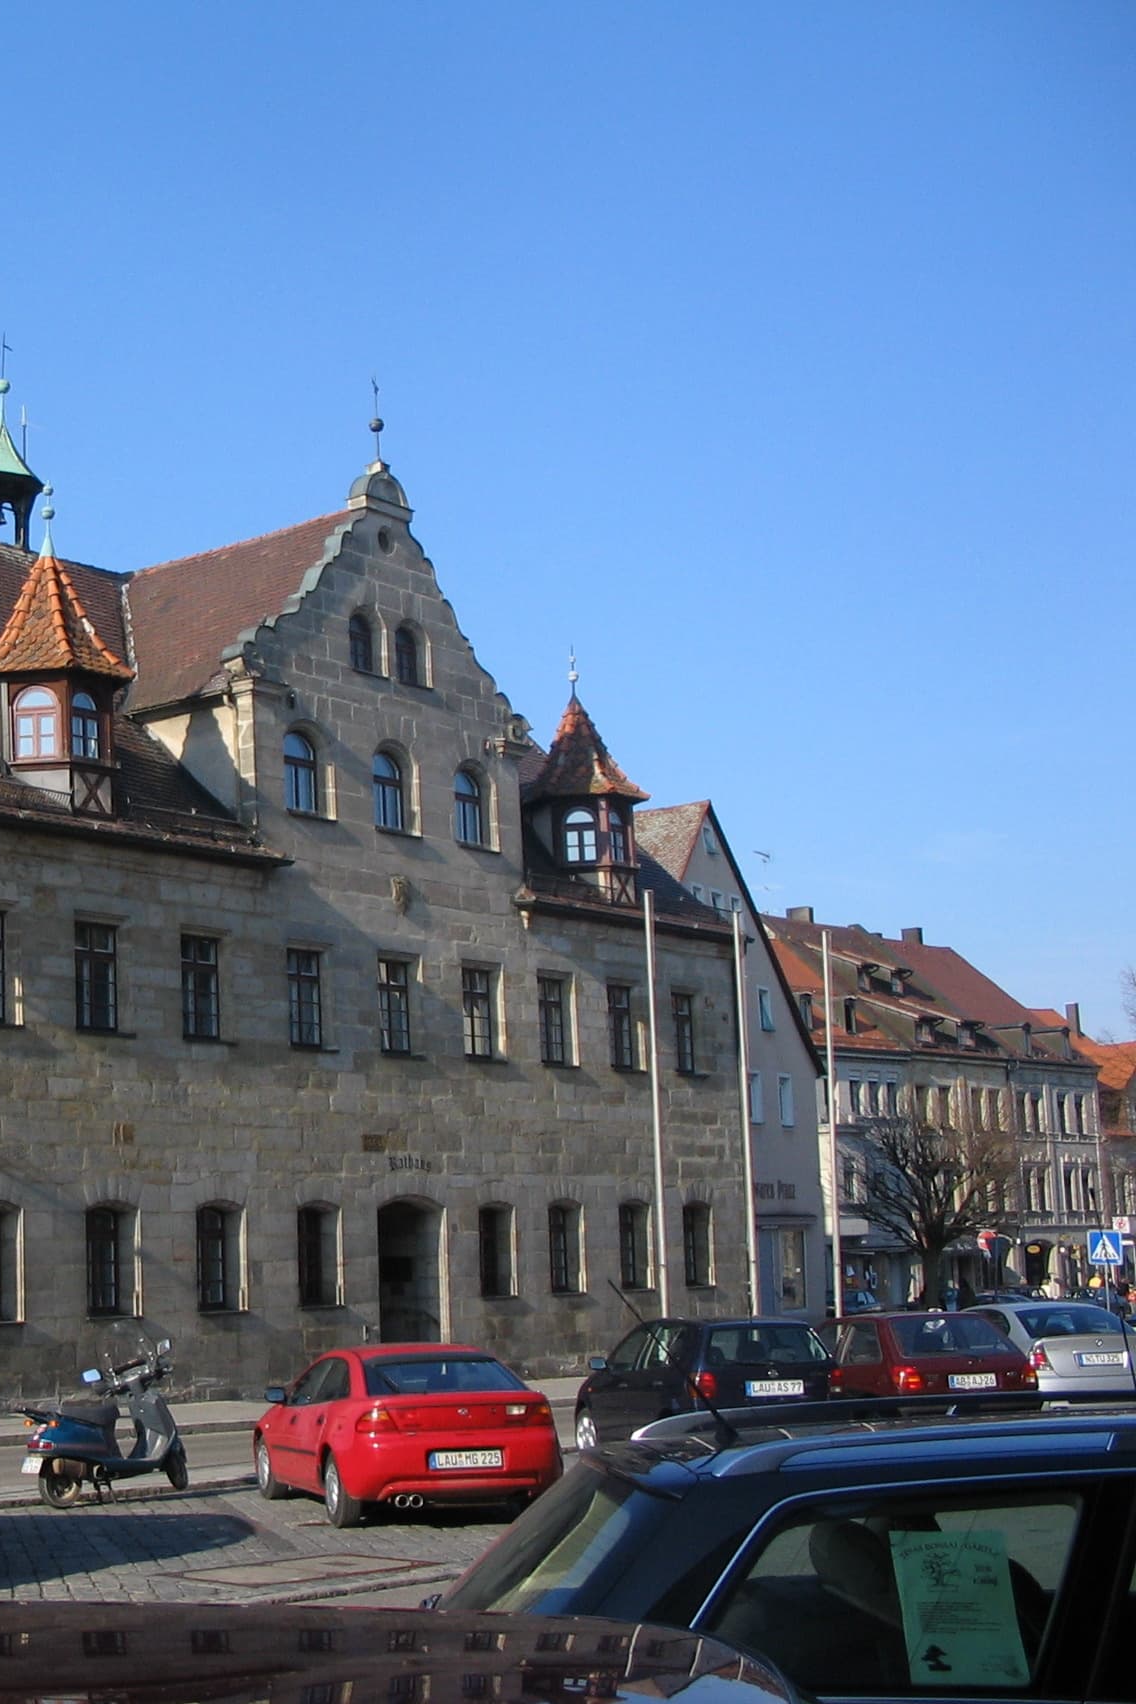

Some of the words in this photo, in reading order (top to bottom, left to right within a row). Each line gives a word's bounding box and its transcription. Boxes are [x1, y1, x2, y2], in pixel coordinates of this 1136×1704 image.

[752, 1383, 771, 1393] LAU
[777, 1382, 789, 1392] AS
[790, 1381, 802, 1392] 77
[438, 1453, 458, 1466] LAU
[480, 1452, 500, 1465] 225
